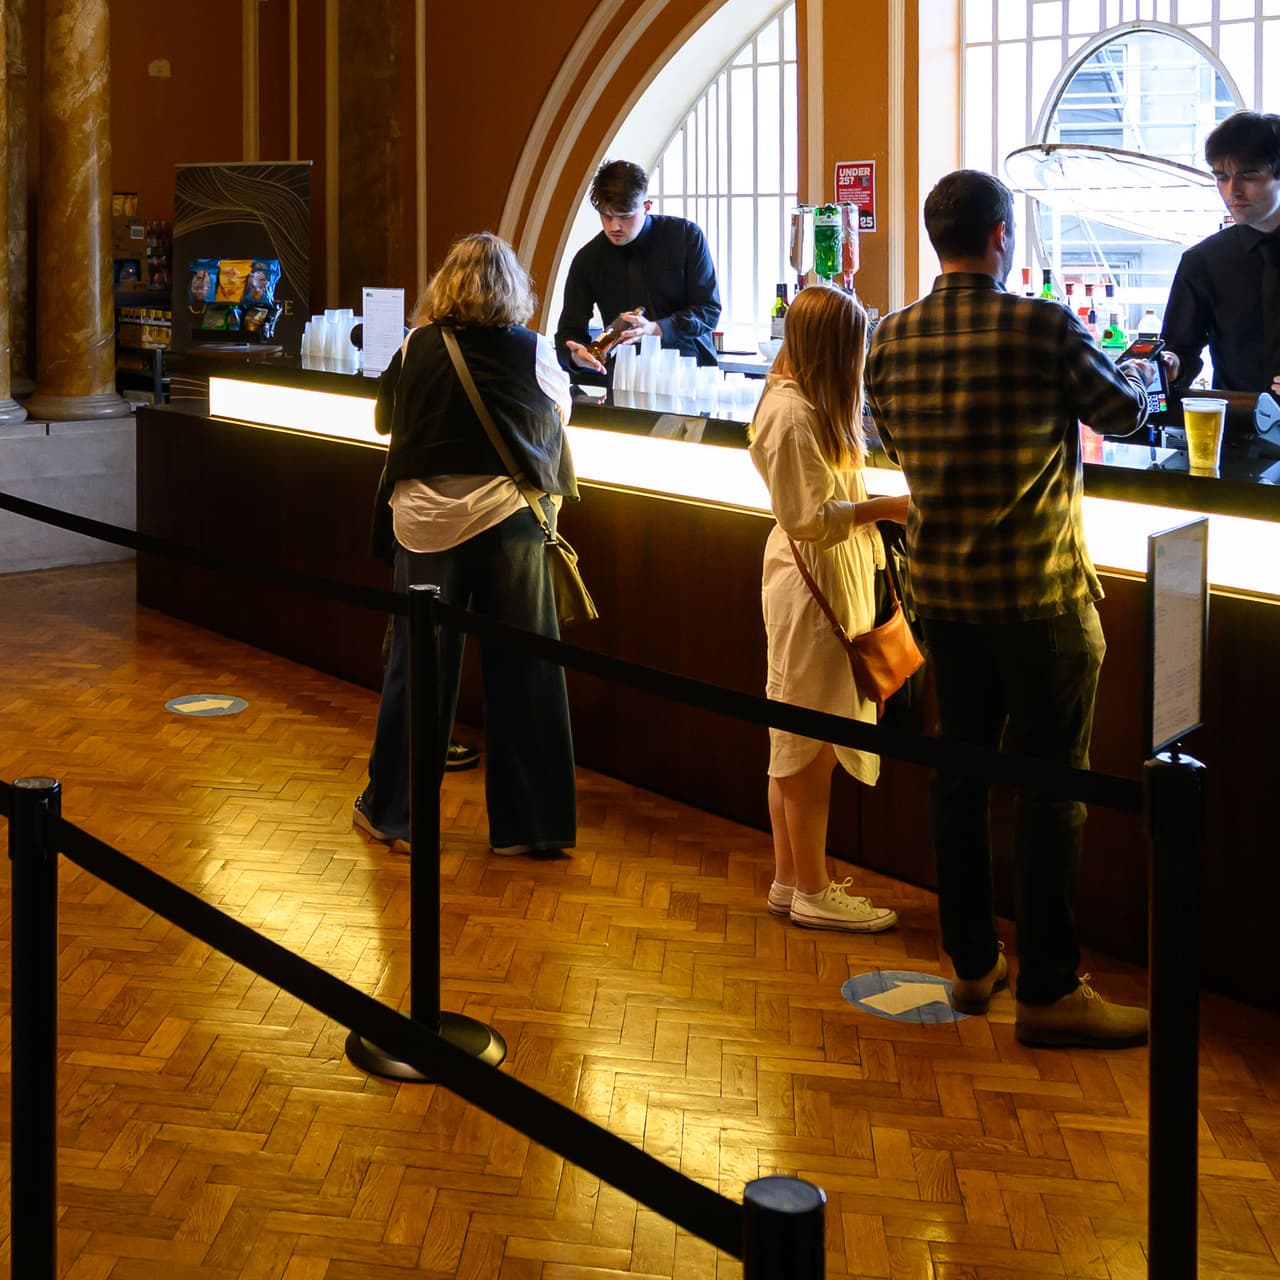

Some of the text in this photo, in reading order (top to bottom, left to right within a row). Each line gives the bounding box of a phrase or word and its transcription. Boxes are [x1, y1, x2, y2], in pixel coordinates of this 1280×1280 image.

[839, 167, 870, 177] UNDER
[839, 176, 854, 186] 25?
[860, 216, 873, 228] 25
